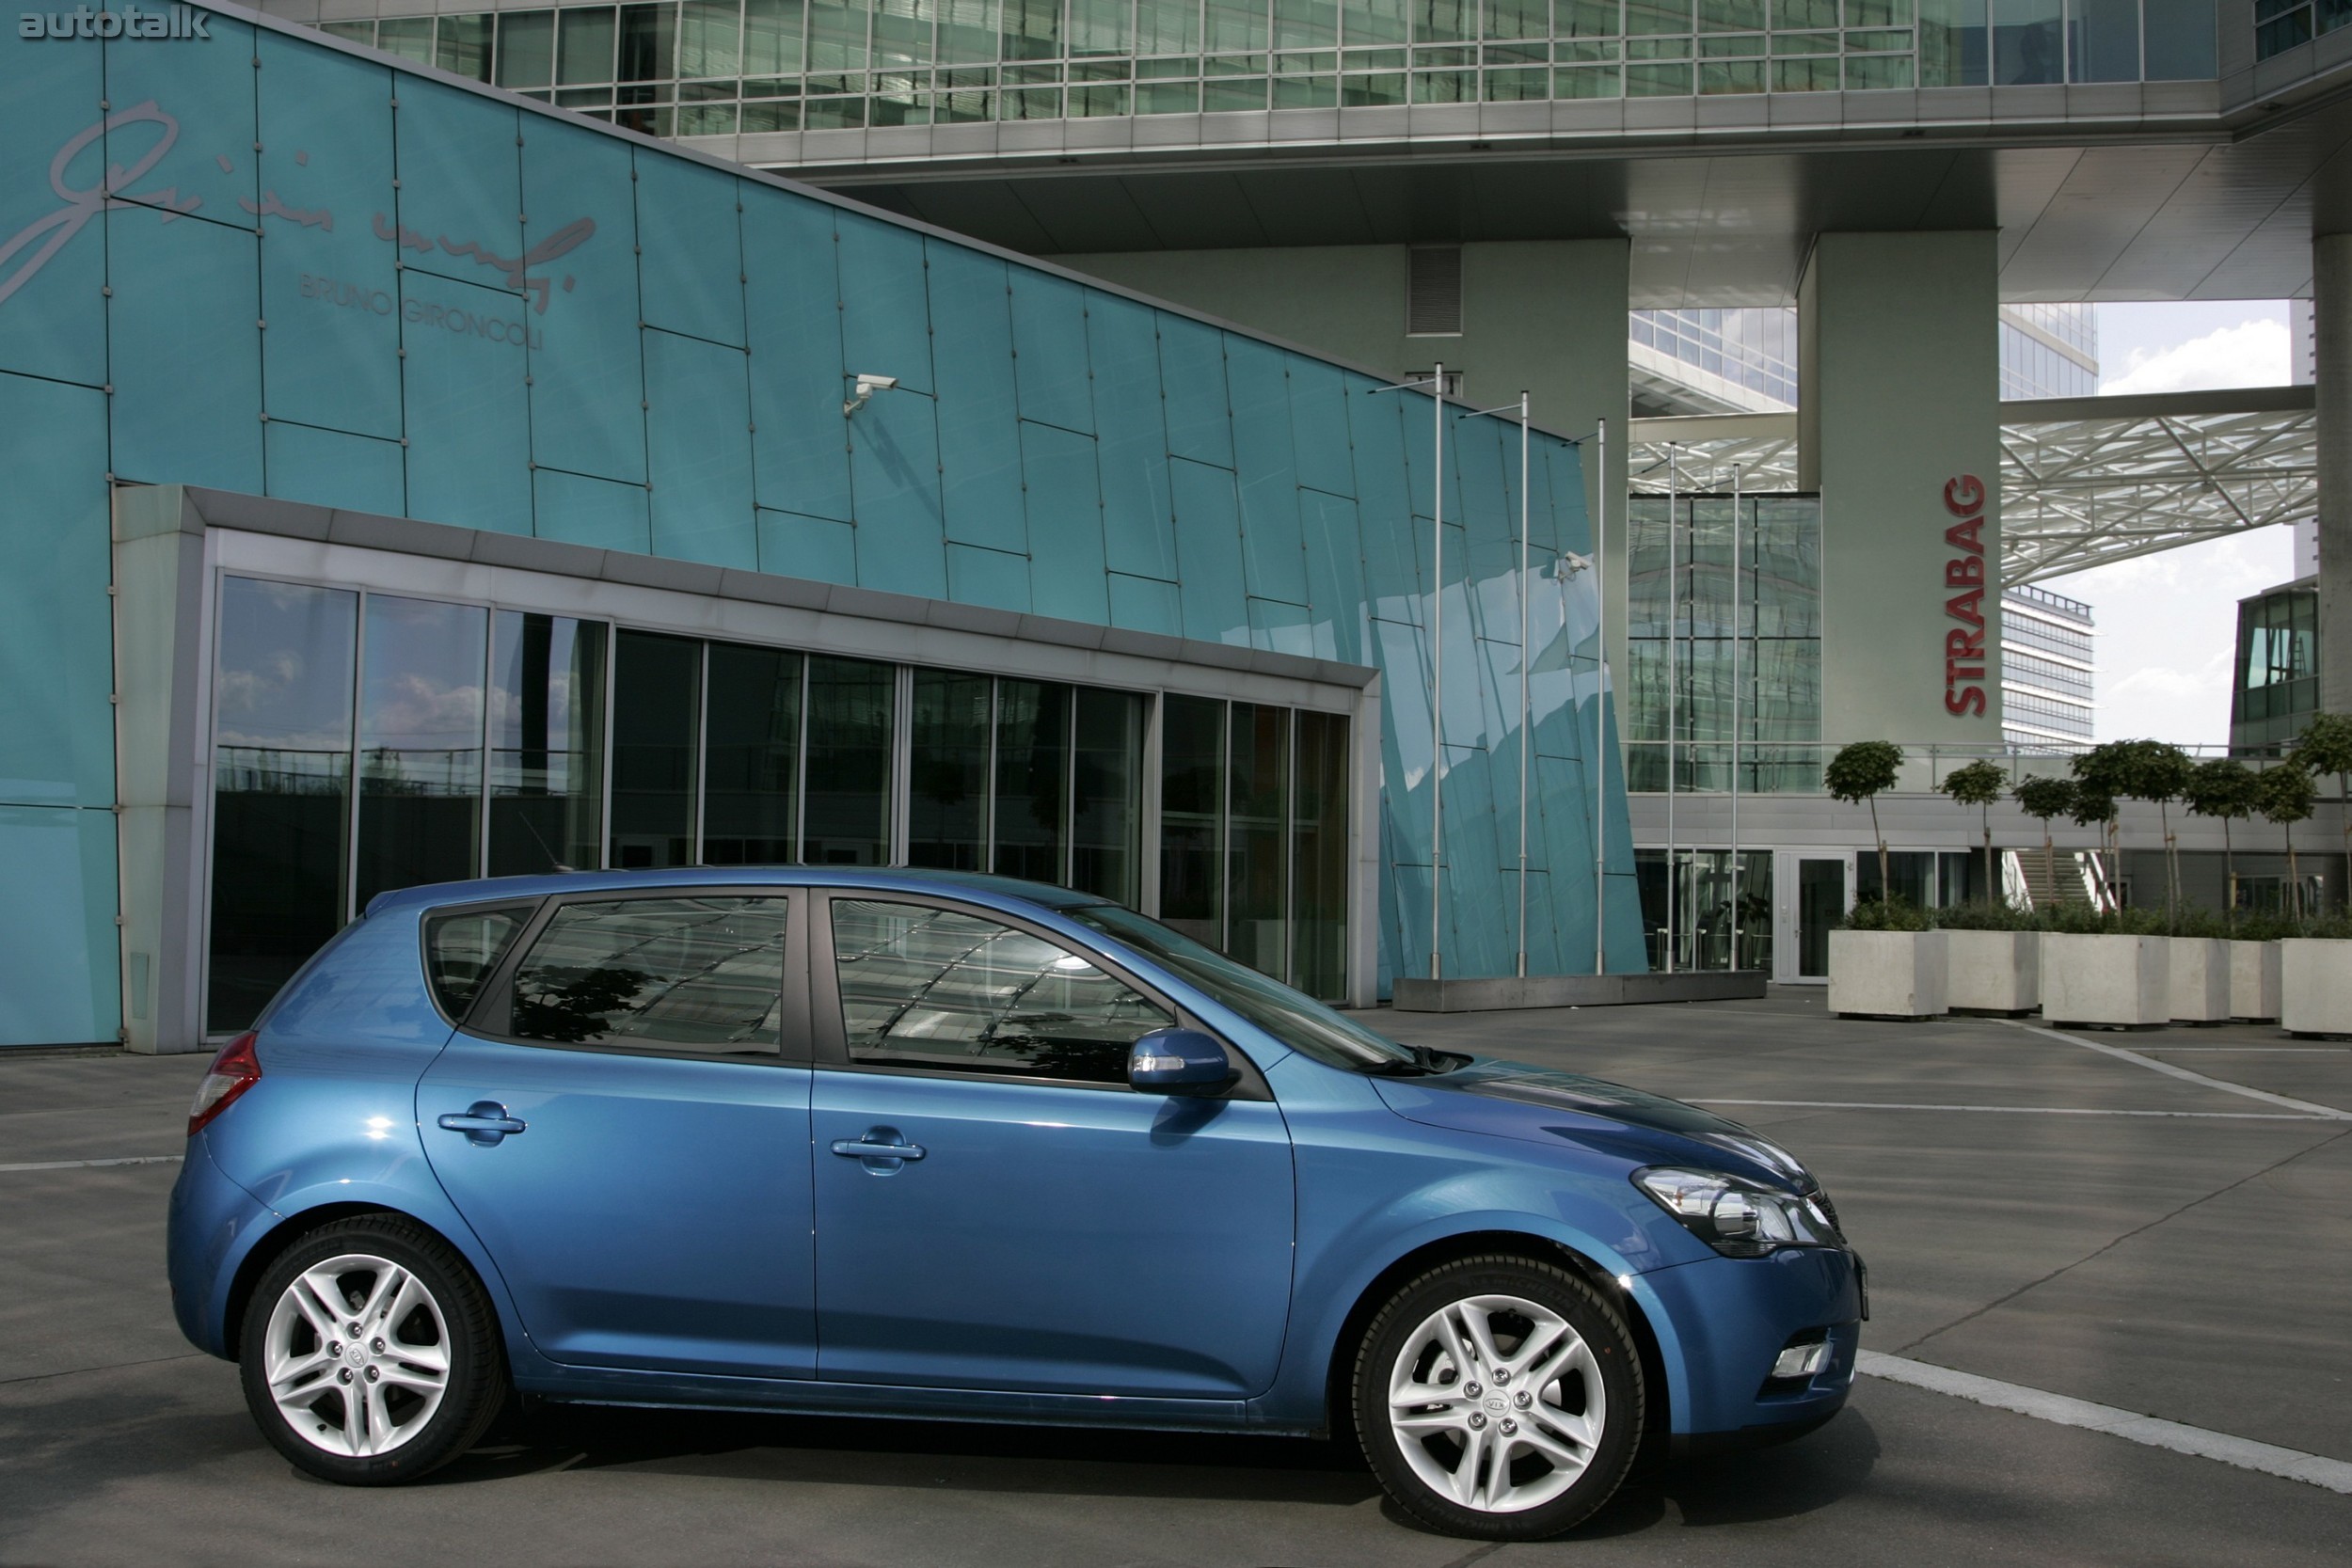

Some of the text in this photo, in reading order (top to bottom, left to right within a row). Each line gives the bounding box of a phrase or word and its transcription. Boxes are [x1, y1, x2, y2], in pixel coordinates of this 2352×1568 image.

[299, 274, 543, 351] BRUNO GIRONCOLI
[1944, 473, 1986, 718] STRABAG
[1493, 1275, 1575, 1308] MICHELIN
